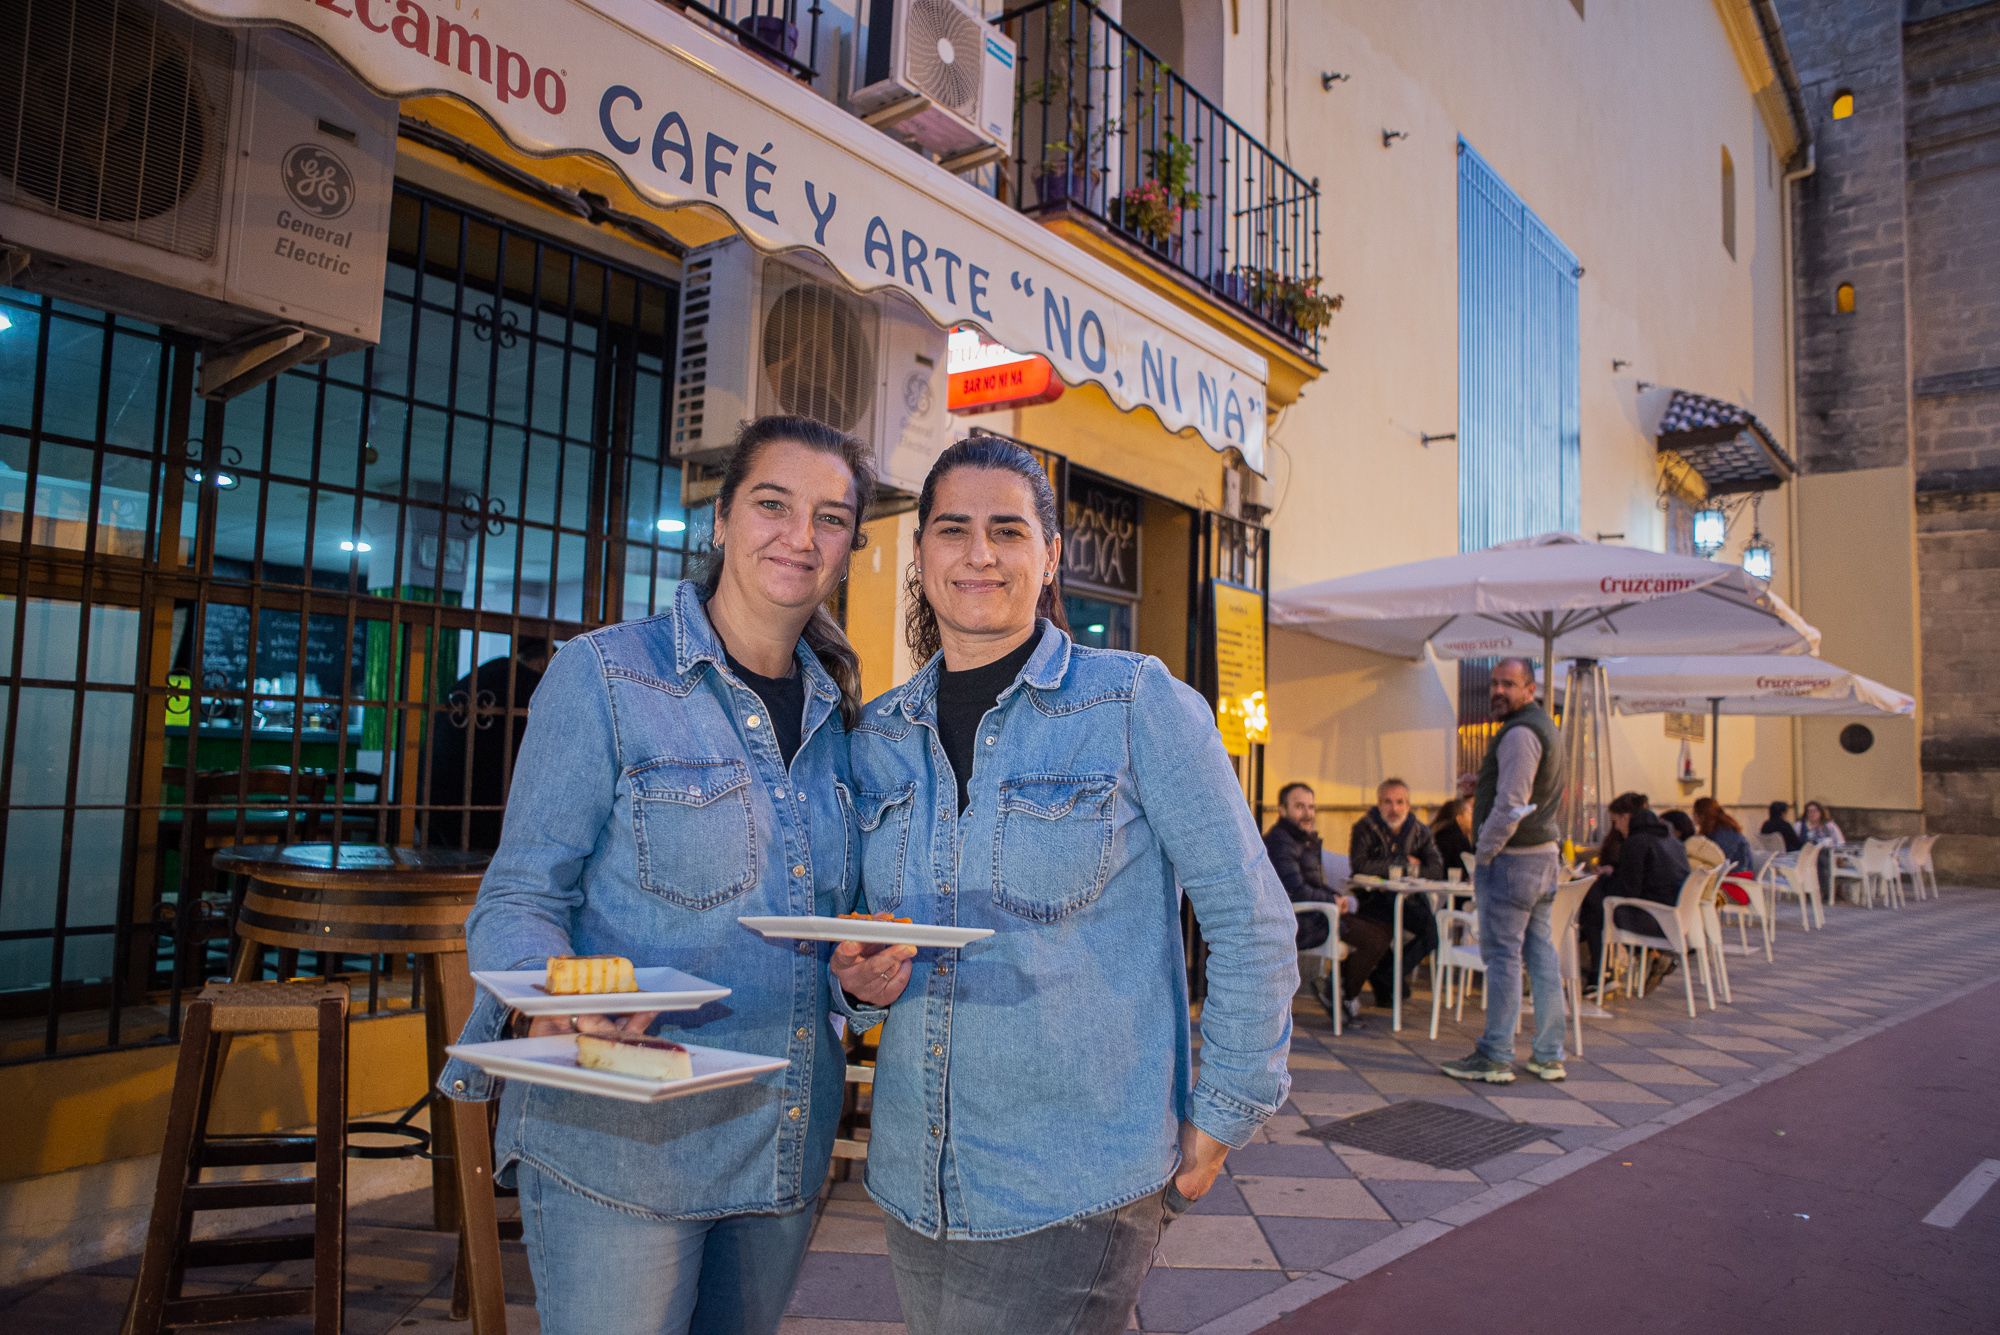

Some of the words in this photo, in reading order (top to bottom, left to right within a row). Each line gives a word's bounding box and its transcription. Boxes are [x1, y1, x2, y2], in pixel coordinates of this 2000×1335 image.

[308, 0, 566, 115] campo
[276, 209, 353, 249] General
[598, 84, 779, 225] CAFÉ
[804, 180, 837, 246] Y
[864, 215, 993, 323] ARTE
[1141, 340, 1182, 413] NI
[274, 236, 351, 275] Electric
[963, 377, 981, 394] BAR
[983, 375, 996, 390] NO
[999, 372, 1008, 387] NI
